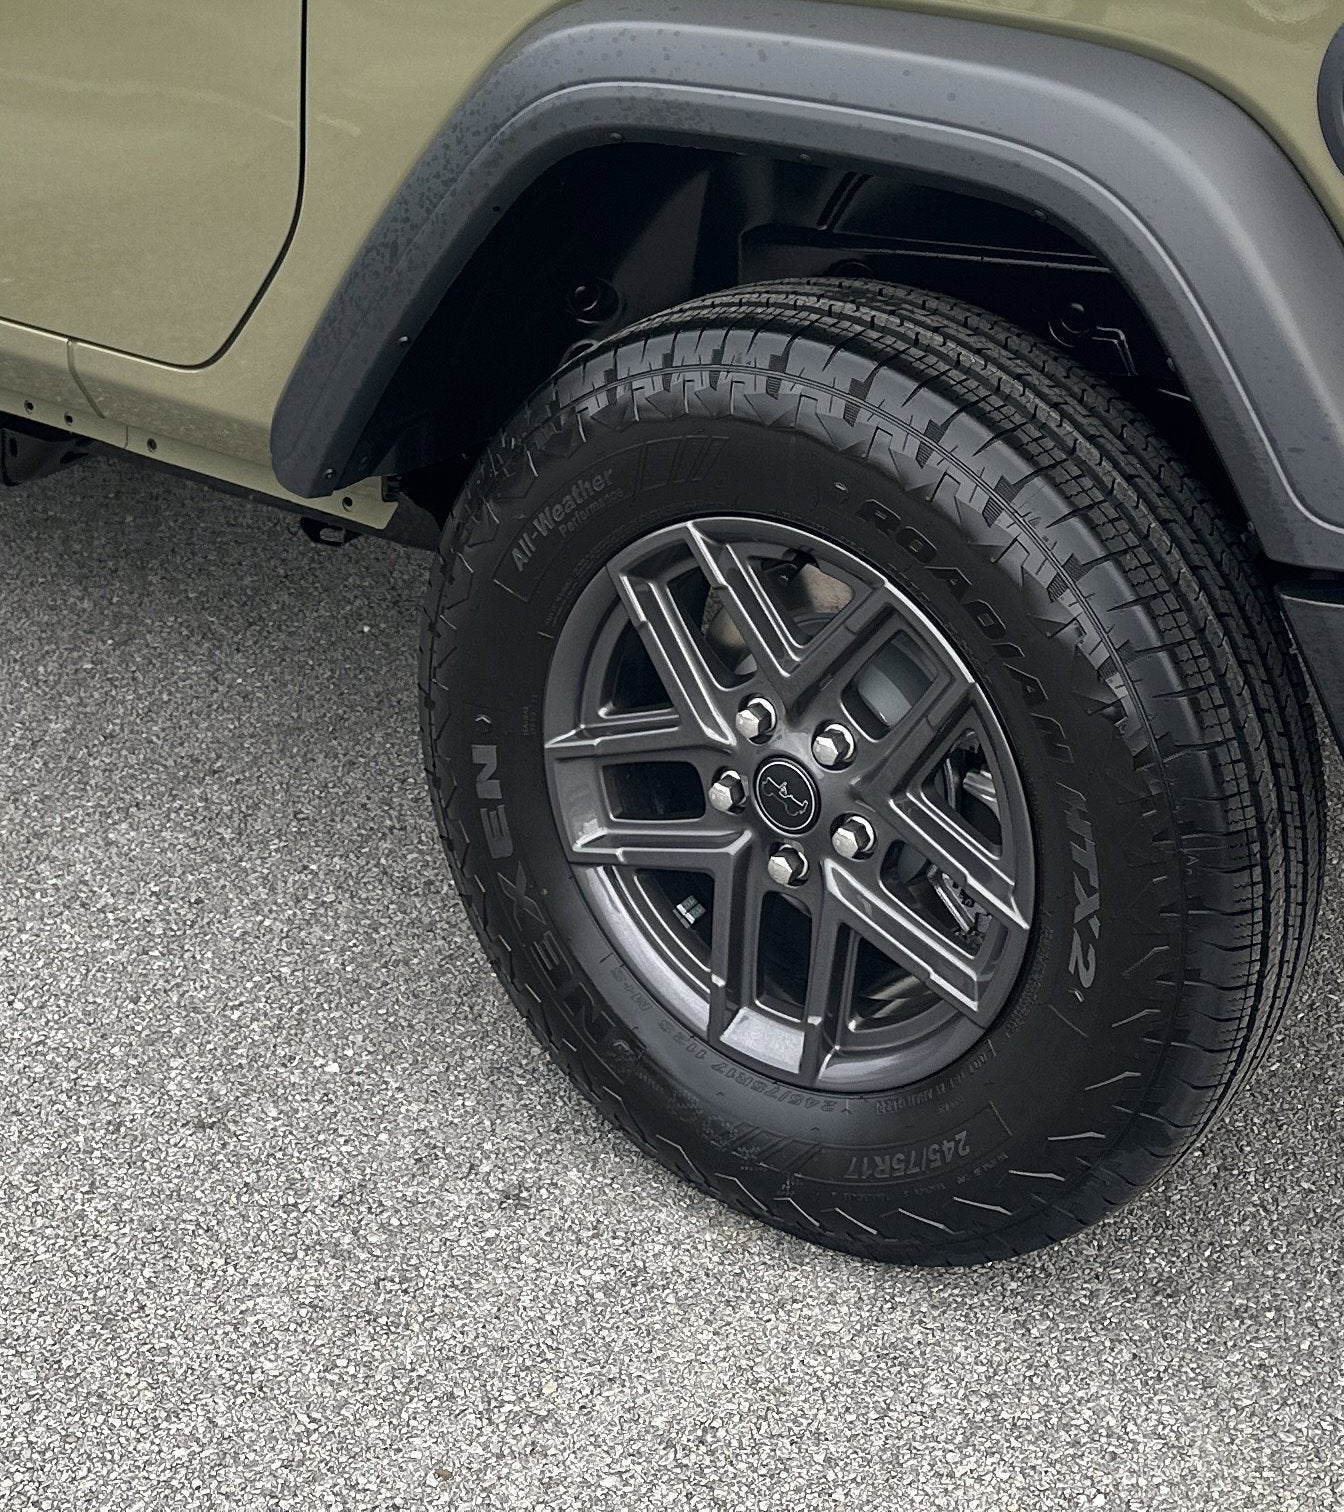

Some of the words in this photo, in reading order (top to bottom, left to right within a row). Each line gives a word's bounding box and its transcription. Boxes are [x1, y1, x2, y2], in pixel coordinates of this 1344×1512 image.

[509, 468, 613, 572] All-Weather
[559, 488, 624, 538] Performance
[854, 498, 1074, 763] ROADIAN
[471, 744, 617, 1045] NEXEN
[709, 1062, 839, 1113] 245/75R17
[843, 1129, 971, 1180] 245/75R17
